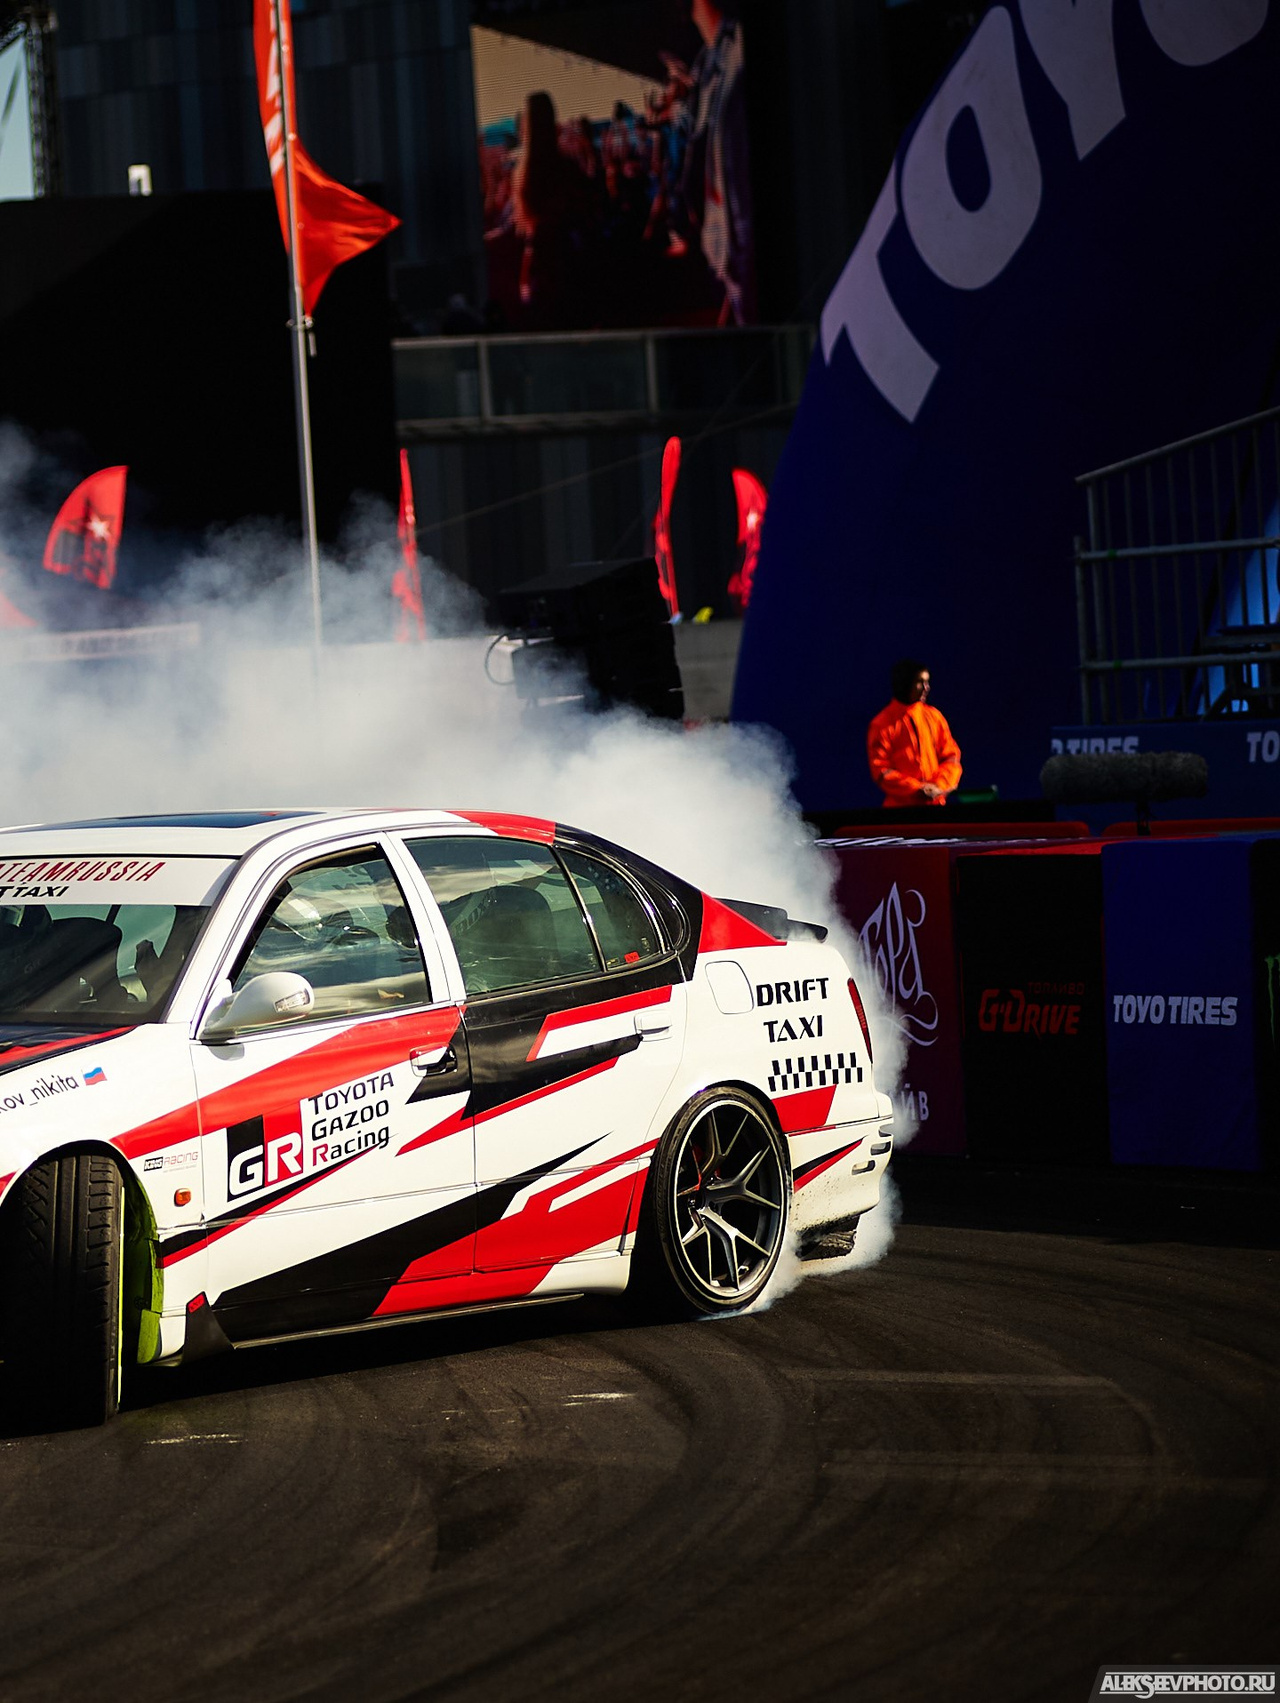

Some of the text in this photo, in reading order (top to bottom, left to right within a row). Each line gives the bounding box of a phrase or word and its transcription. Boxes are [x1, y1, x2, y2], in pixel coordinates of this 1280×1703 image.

[12, 885, 70, 899] TAXI
[756, 977, 829, 1007] DRIFT
[1113, 994, 1239, 1027] TOYO TIRES
[763, 1015, 824, 1043] TAXI
[307, 1071, 395, 1116] TOYOTA
[311, 1099, 390, 1140] GAZOO
[229, 1130, 304, 1196] GR
[312, 1124, 391, 1167] Racing
